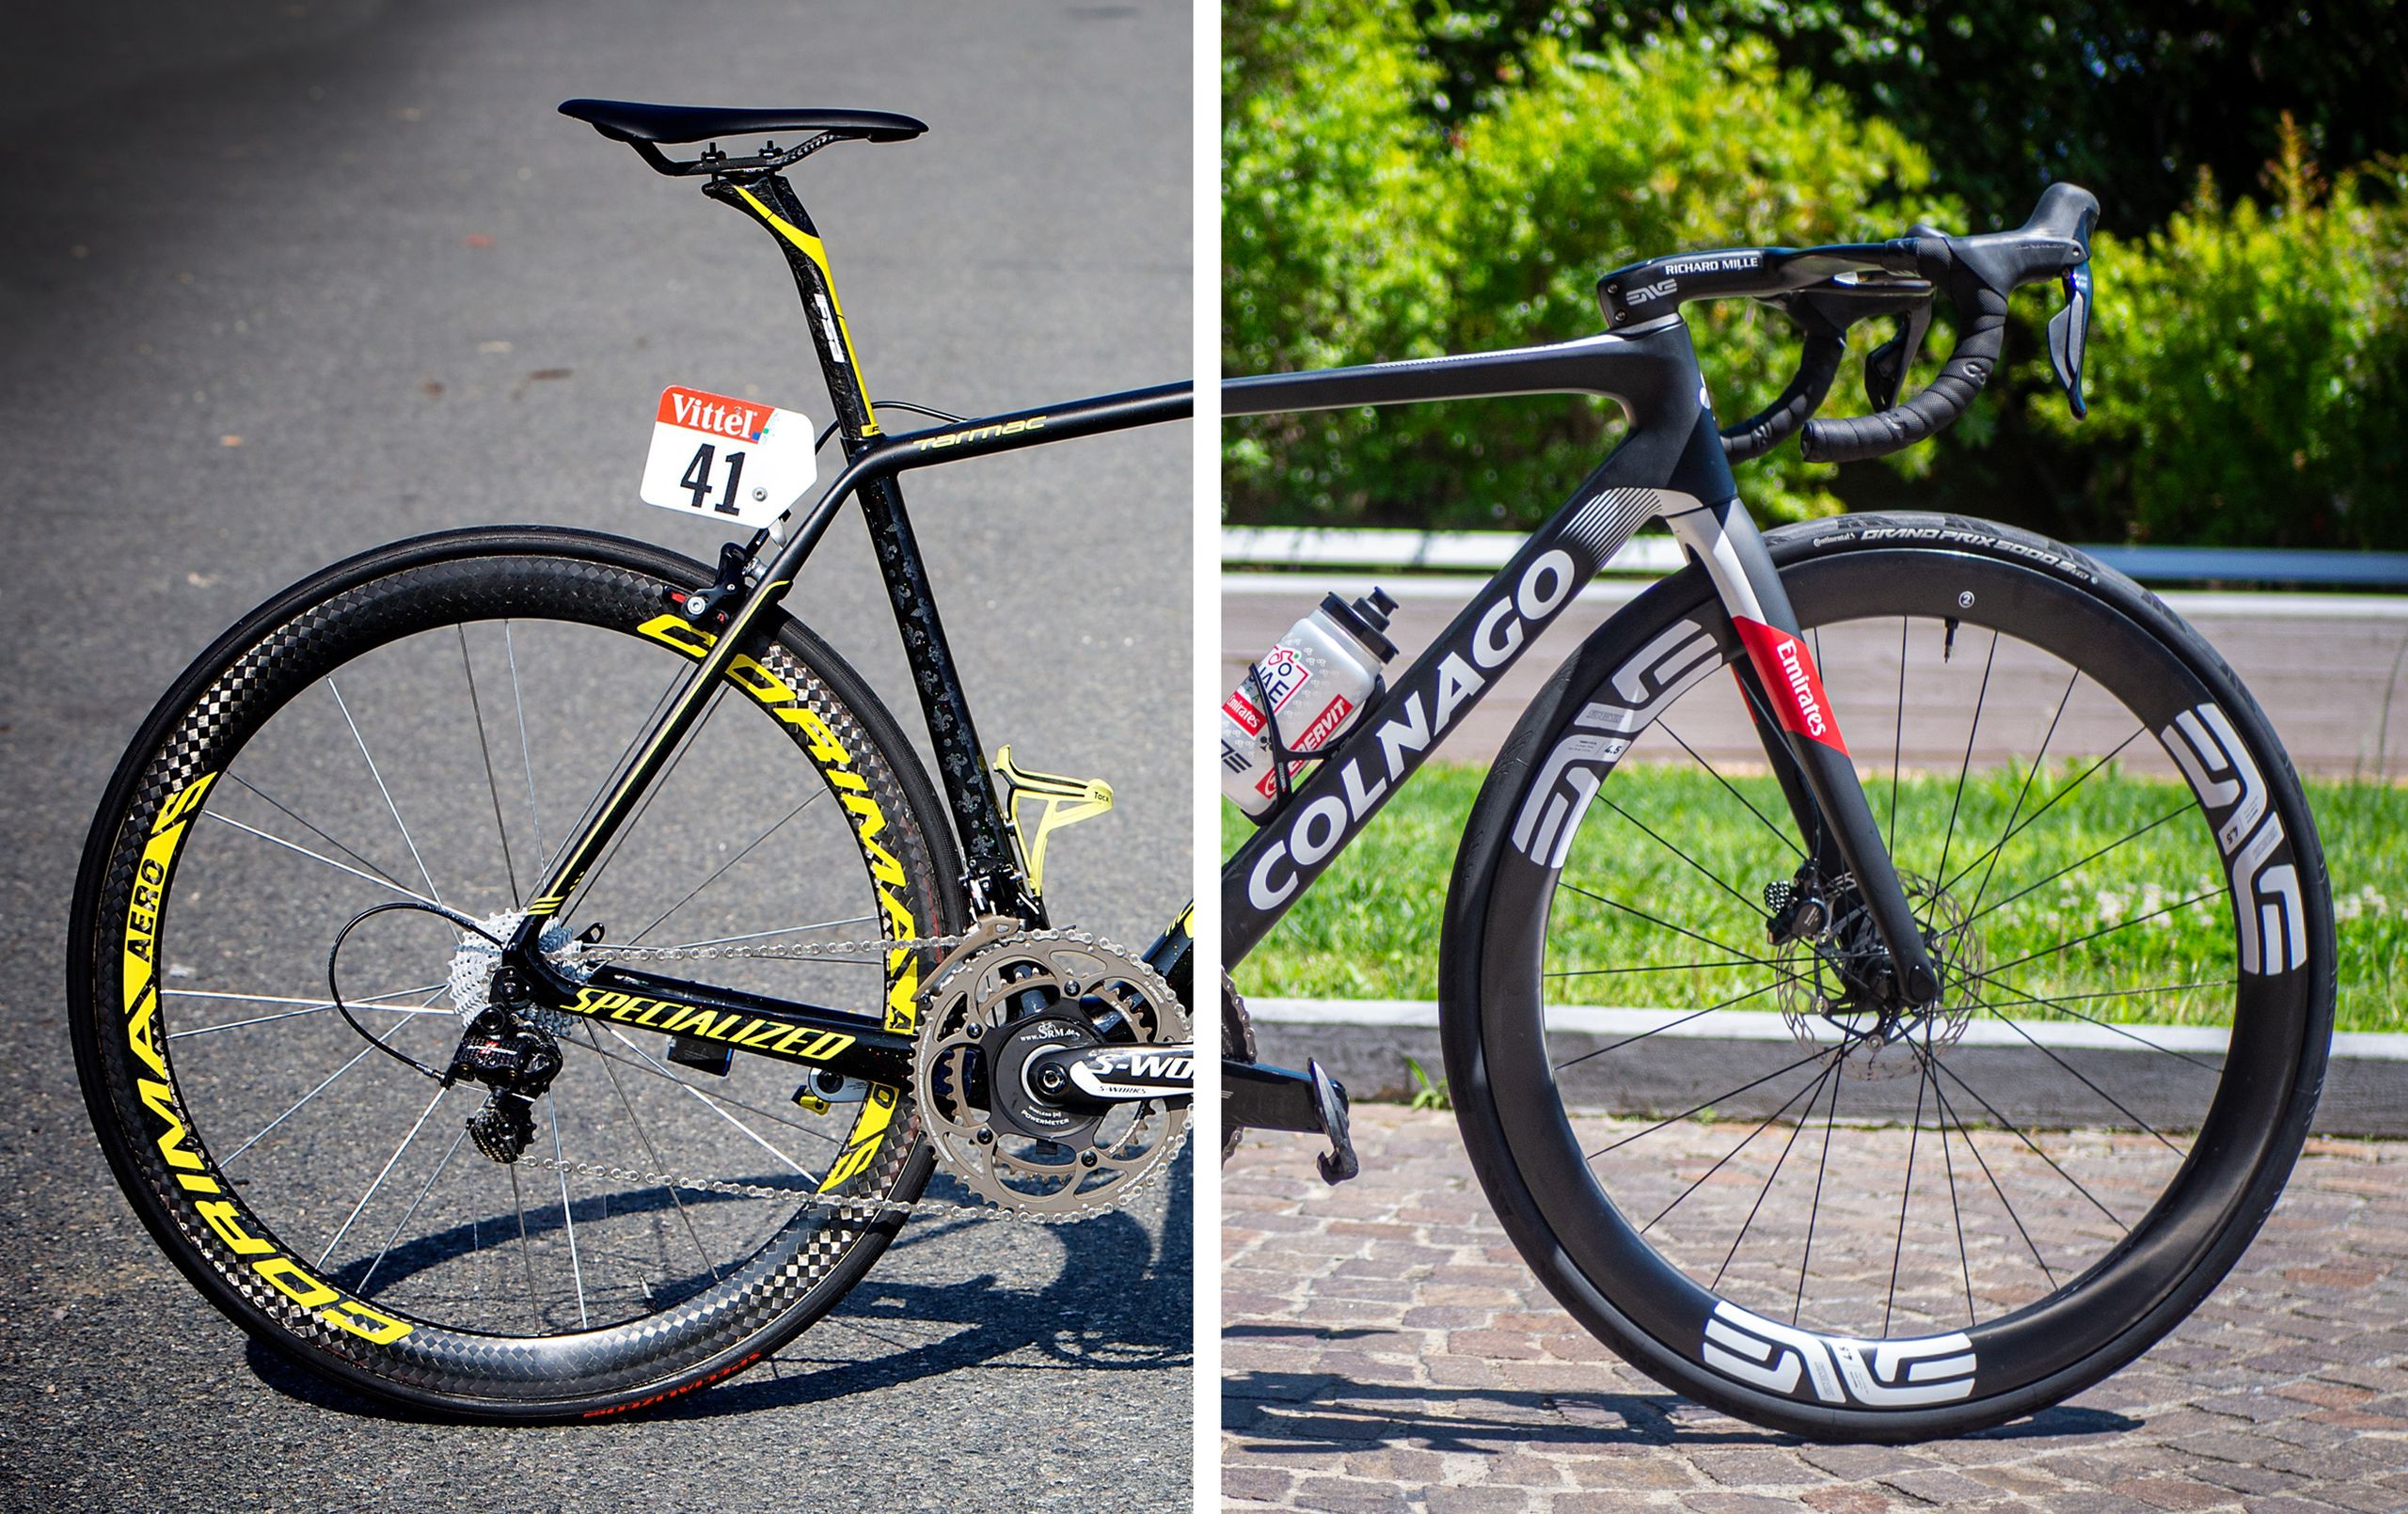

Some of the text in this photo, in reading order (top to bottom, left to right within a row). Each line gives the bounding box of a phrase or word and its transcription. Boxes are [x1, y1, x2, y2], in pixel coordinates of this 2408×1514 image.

[1665, 257, 1758, 276] RICHARD MILLE
[1626, 278, 1678, 306] ENVE
[673, 393, 758, 438] Vittel
[680, 443, 746, 516] 41
[1861, 528, 1940, 541] GRAND
[1939, 529, 1995, 547] PRIX
[1993, 539, 2059, 565] 5000
[1777, 639, 1826, 736] Emirates
[1226, 694, 1260, 728] Emirates
[1248, 549, 1576, 910] COLNAGO
[1605, 744, 1622, 754] 4.5
[2226, 824, 2239, 845] 4.5
[127, 858, 165, 964] AERO
[561, 987, 857, 1061] SPECIALIZED
[1091, 1054, 1194, 1080] S-WO
[129, 986, 414, 1345] CORIMA
